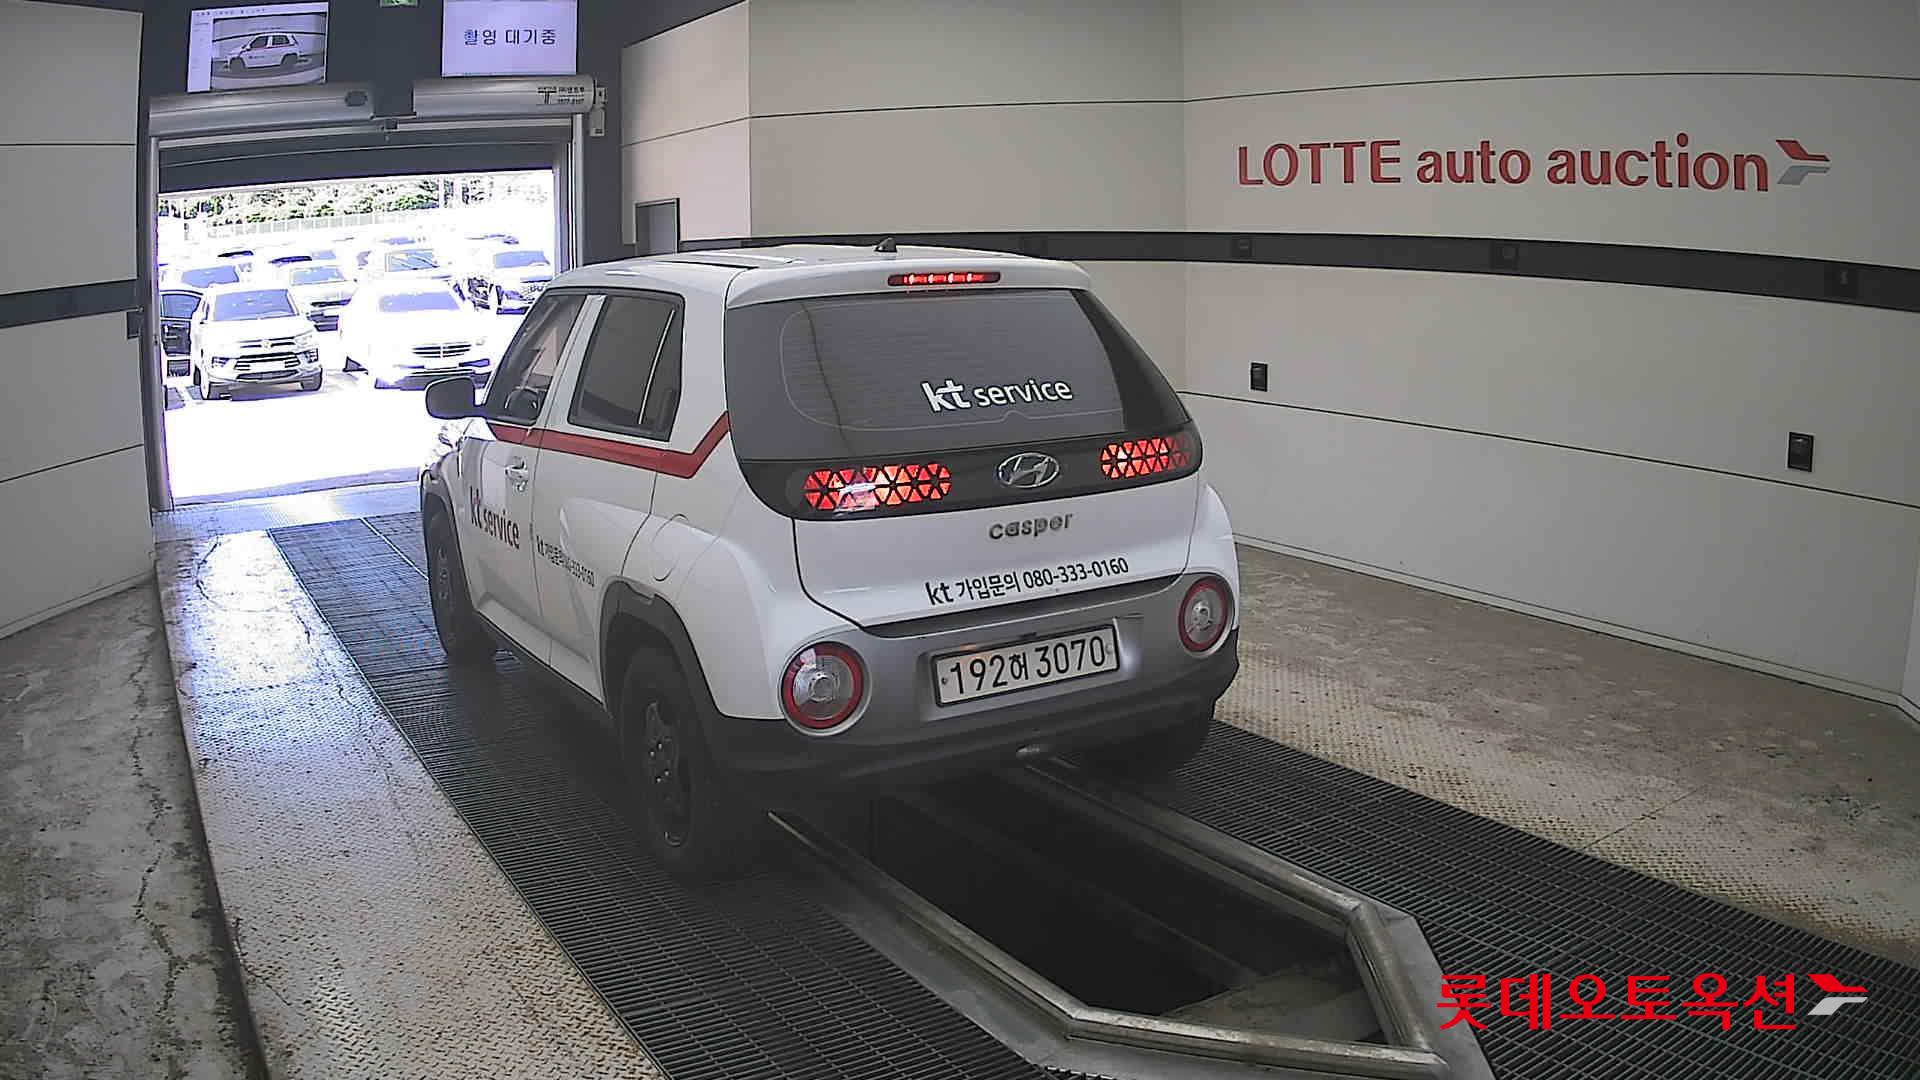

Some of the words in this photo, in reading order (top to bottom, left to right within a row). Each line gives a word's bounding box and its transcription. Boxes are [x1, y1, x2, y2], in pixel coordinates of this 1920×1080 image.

[464, 29, 496, 45] 촬영
[505, 29, 556, 45] 대기중
[1237, 139, 1401, 187] LOTTE
[1416, 139, 1532, 186] auto
[1546, 132, 1769, 193] auction
[921, 379, 972, 412] kt
[973, 379, 1073, 407] service
[470, 486, 483, 529] kt
[483, 508, 520, 550] service
[988, 513, 1074, 541] casper
[925, 581, 954, 606] kt
[955, 571, 1021, 601] 가입문의
[1023, 557, 1129, 589] 080-333-0160
[950, 651, 1029, 695] 192허
[1034, 635, 1106, 679] 3070
